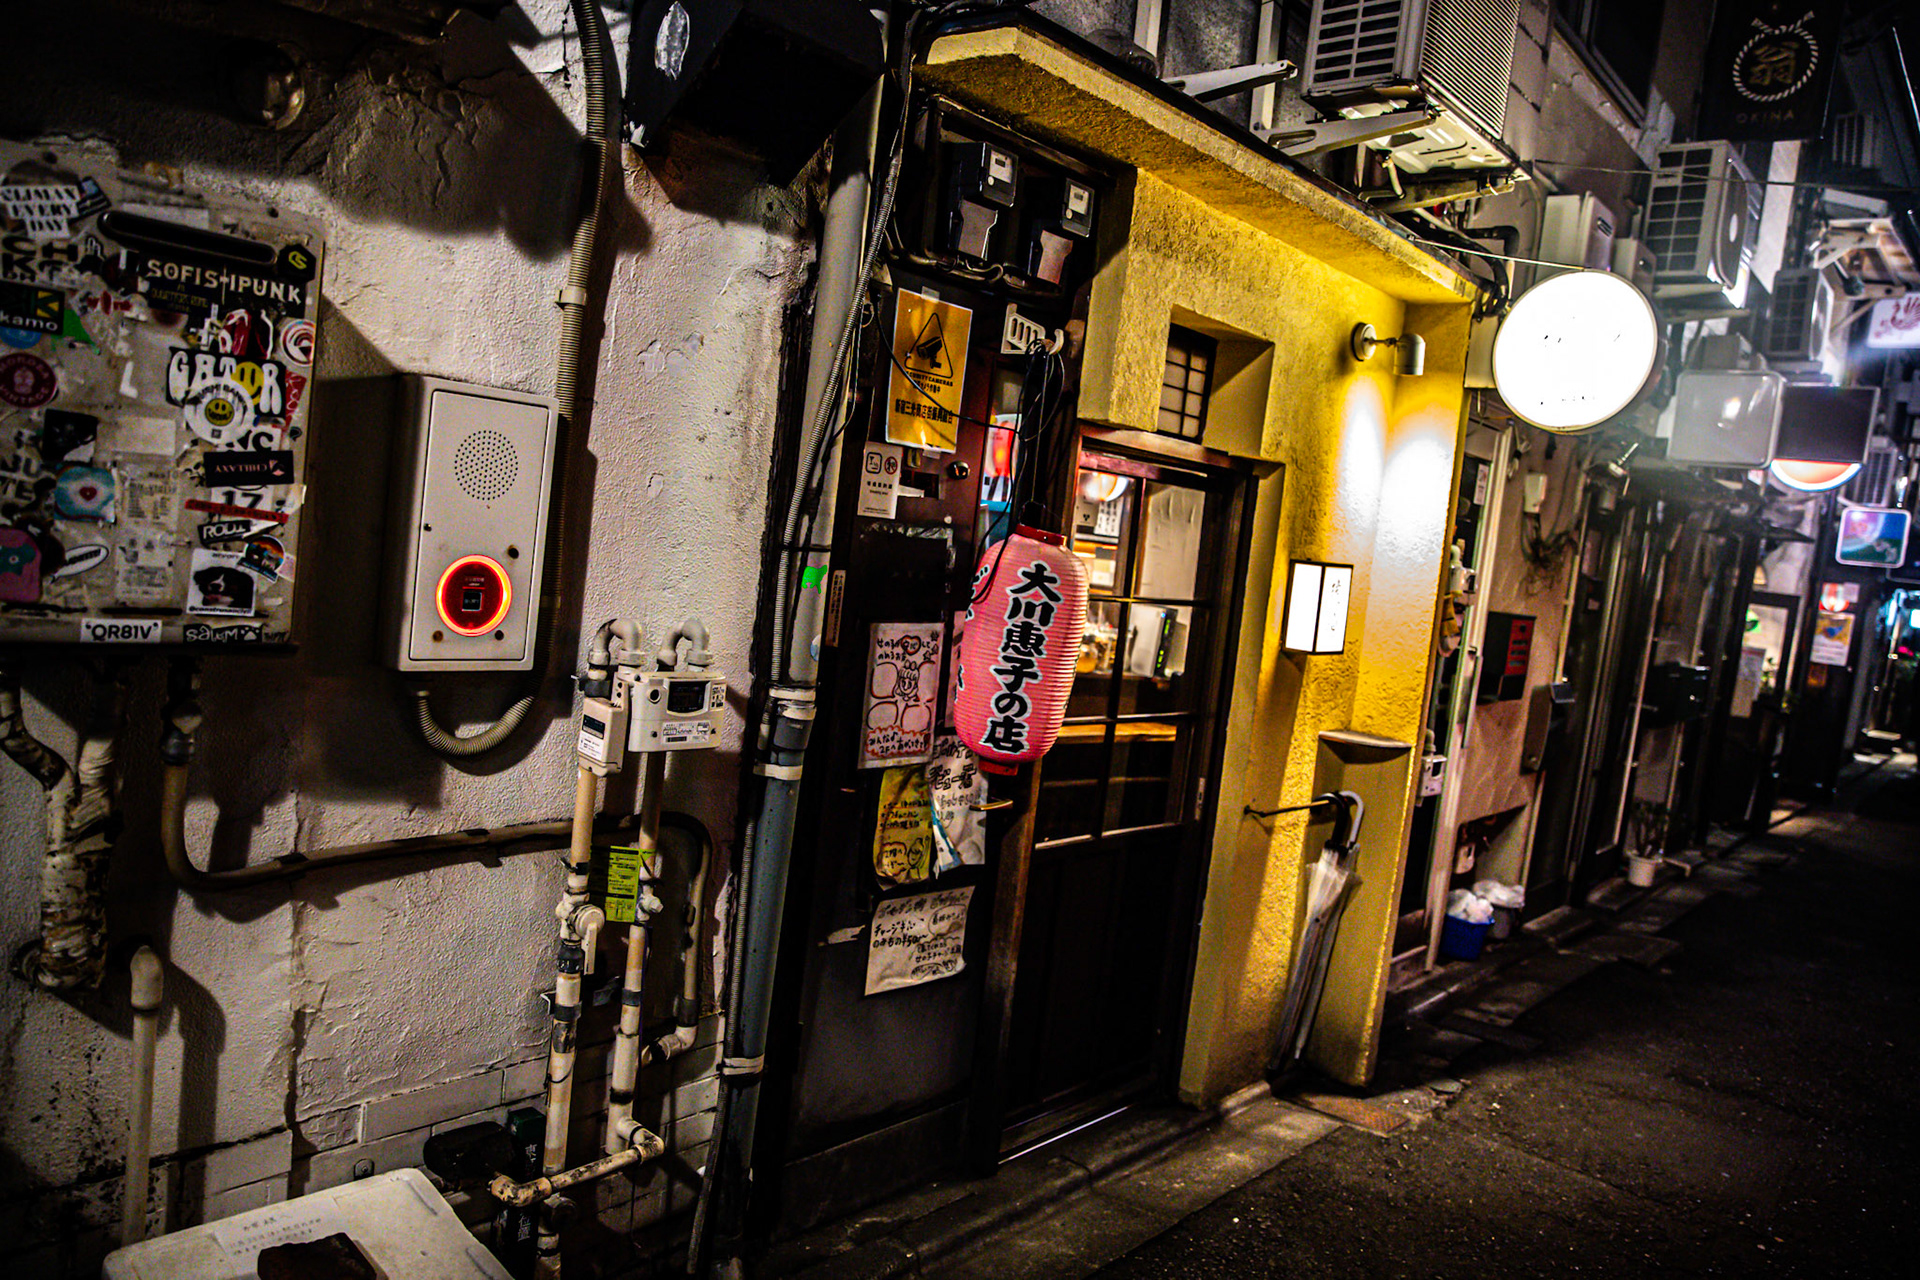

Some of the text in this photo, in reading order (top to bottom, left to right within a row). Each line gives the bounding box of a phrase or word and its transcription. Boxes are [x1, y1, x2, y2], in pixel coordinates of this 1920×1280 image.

[1736, 110, 1795, 124] OKINA
[929, 377, 953, 387] CAMERAS
[981, 563, 1061, 754] 大川恵子の店
